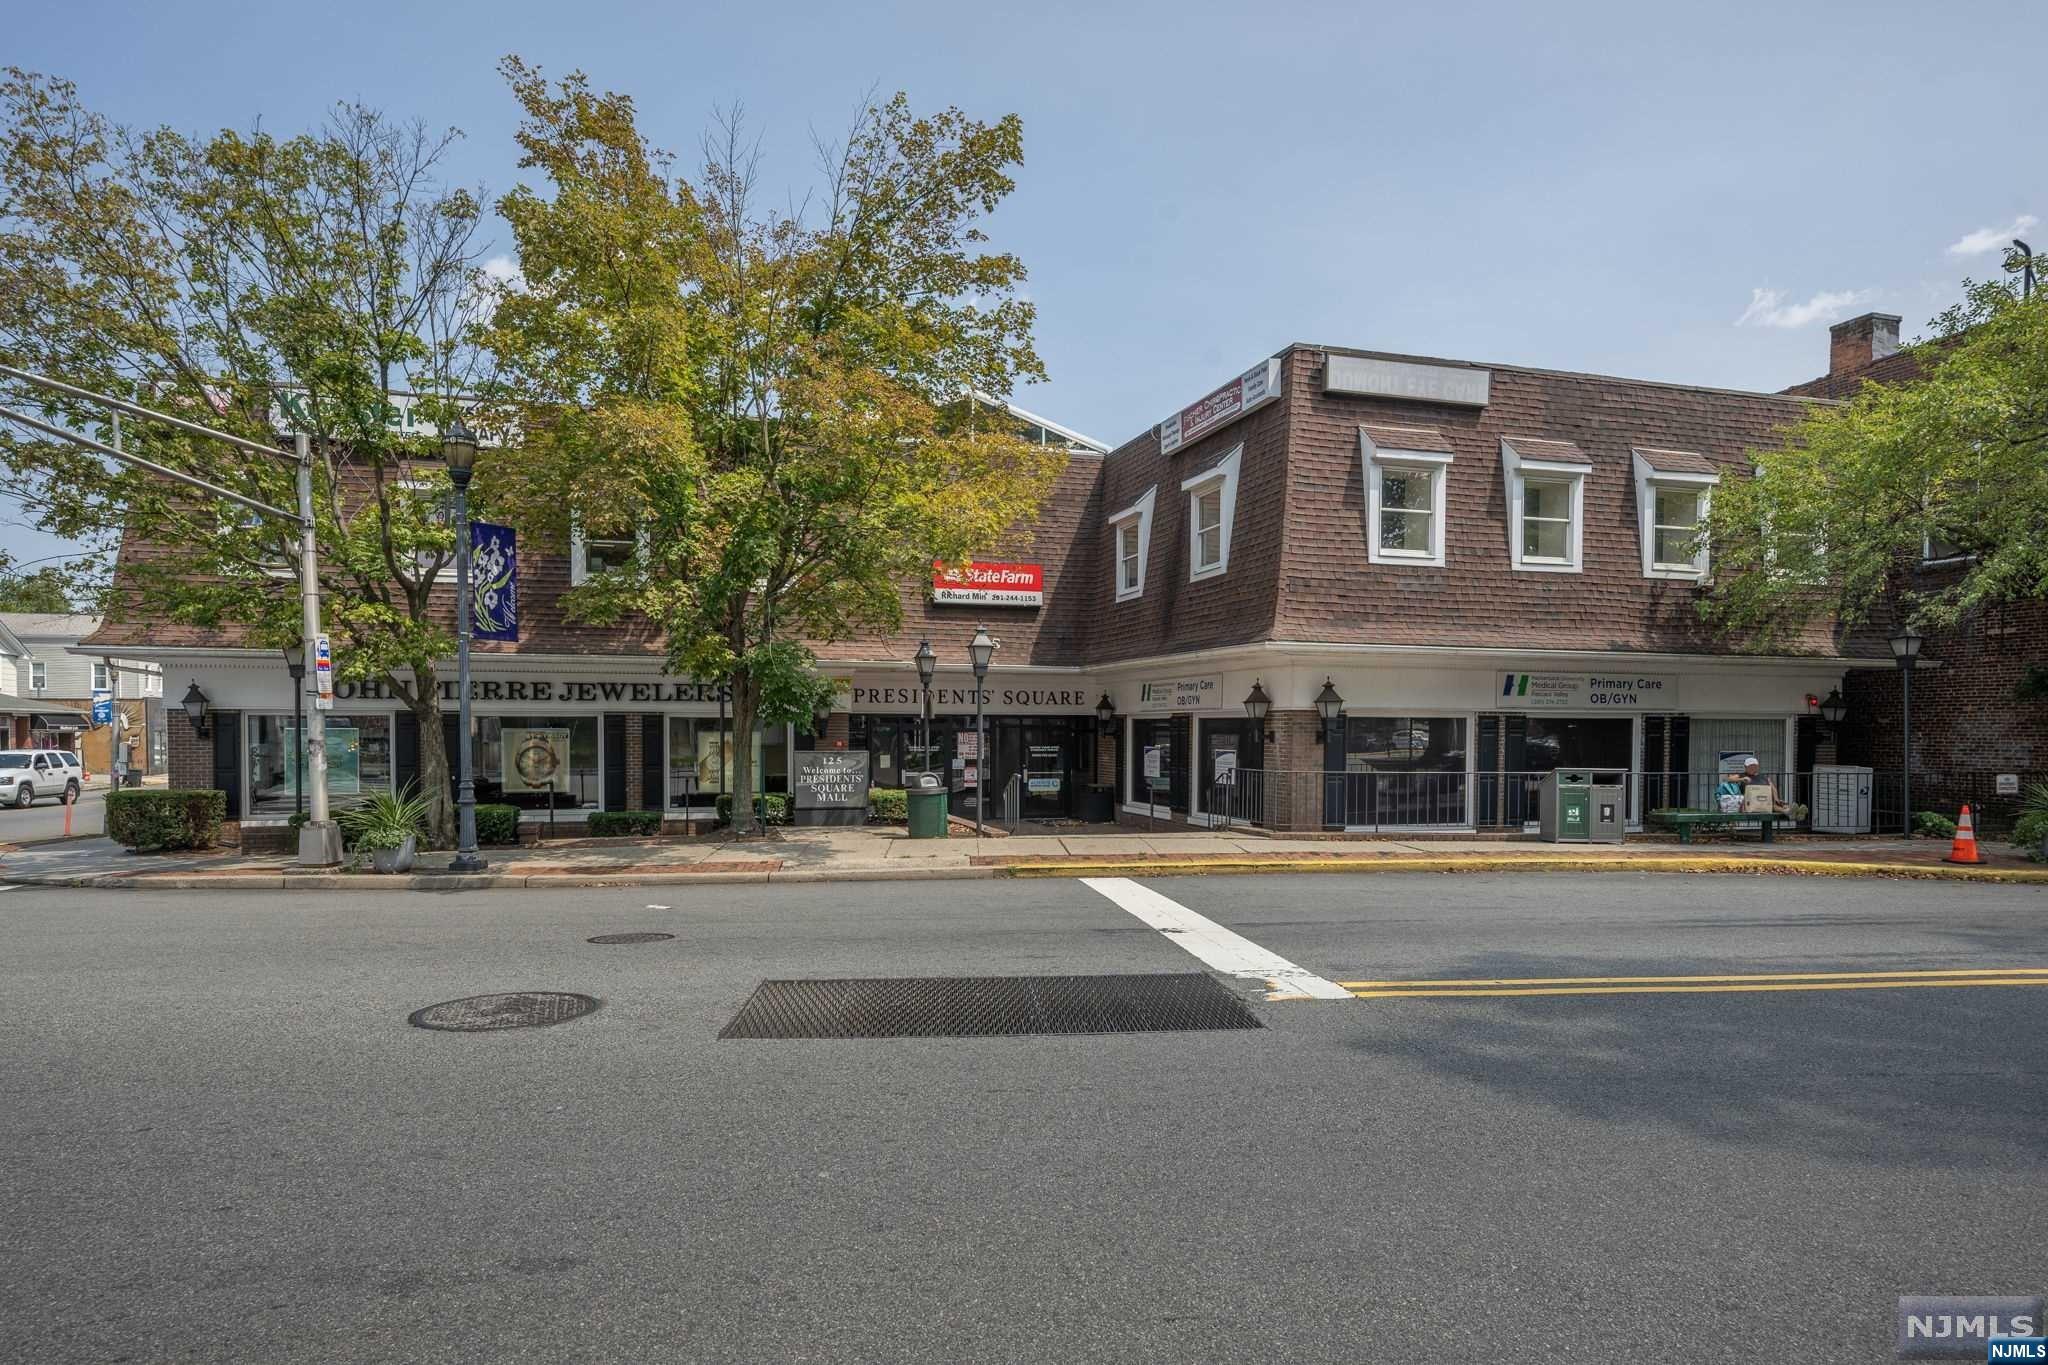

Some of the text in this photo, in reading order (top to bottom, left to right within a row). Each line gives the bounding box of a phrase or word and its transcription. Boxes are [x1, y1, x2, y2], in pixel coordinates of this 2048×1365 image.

[1213, 398, 1234, 414] CENTER
[1177, 679, 1215, 692] Primary Care
[1590, 678, 1632, 690] Primary
[1637, 678, 1662, 690] Care
[1003, 690, 1085, 705] SQUARE
[1177, 695, 1200, 706] OB/GYN
[1590, 693, 1637, 705] OB/GYN
[802, 766, 841, 774] Welcome
[800, 775, 864, 784] PRESIDENTS'
[810, 784, 855, 793] SQUARE
[817, 793, 848, 802] MALL
